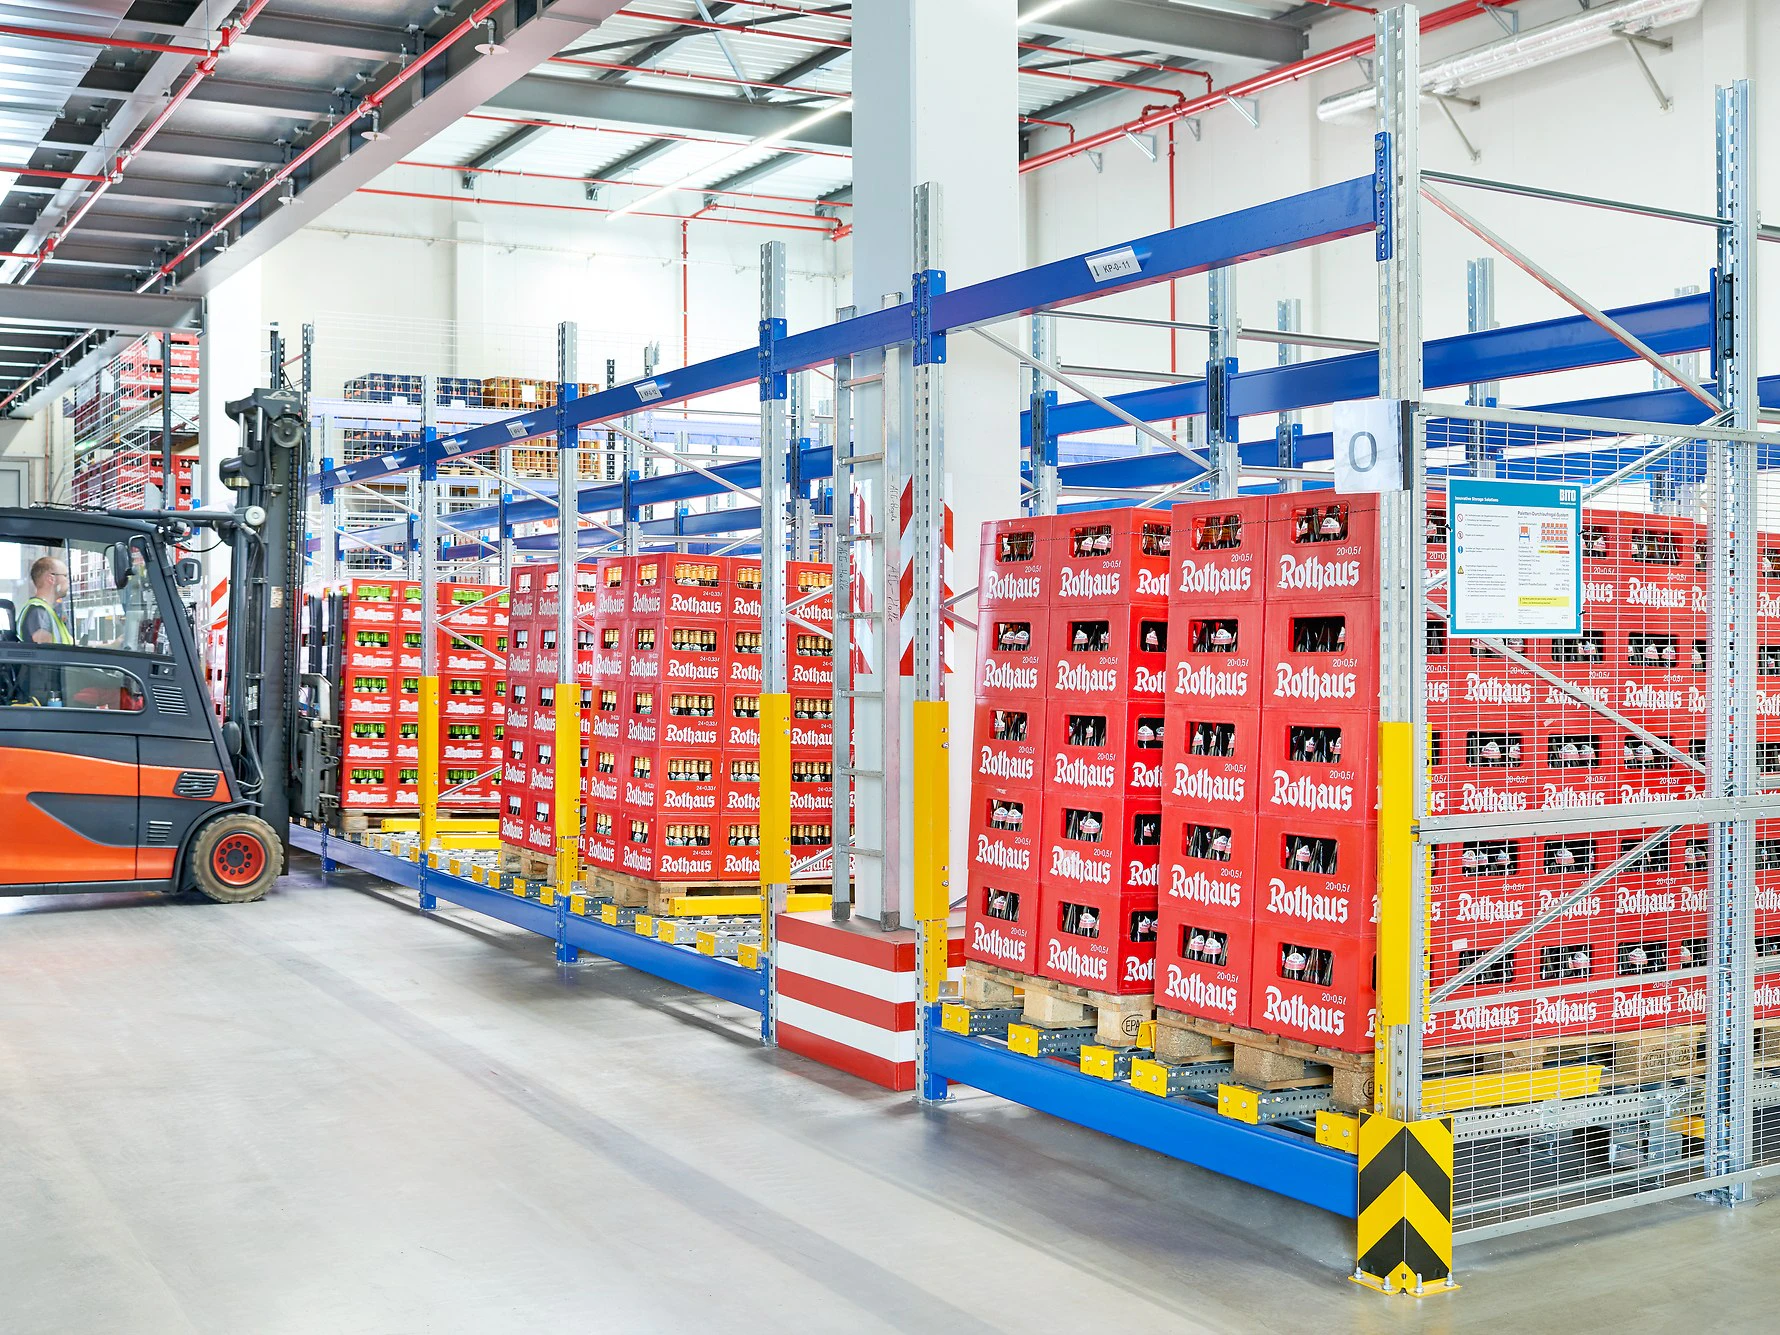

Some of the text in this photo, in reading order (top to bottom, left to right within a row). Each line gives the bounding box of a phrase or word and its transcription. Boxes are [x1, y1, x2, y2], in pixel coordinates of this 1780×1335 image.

[1560, 489, 1576, 501] BITO
[986, 571, 1041, 601] Rothaus
[1059, 567, 1120, 599] Rothaus
[1179, 560, 1252, 595] Rothaus
[1277, 554, 1360, 591] Rothaus
[670, 594, 722, 614] Rothaus
[1626, 577, 1686, 609] Rothaus
[667, 659, 719, 680] Rothaus
[983, 659, 1038, 692] Rothaus
[1055, 660, 1117, 694] Rothaus
[1175, 662, 1248, 699] Rothaus
[1273, 663, 1356, 702] Rothaus
[1464, 673, 1531, 706] Rothaus
[1623, 680, 1682, 712] Rothaus
[665, 724, 717, 745] Rothaus
[979, 745, 1034, 780] Rothaus
[1054, 753, 1115, 789] Rothaus
[1172, 762, 1245, 803] Rothaus
[1270, 770, 1353, 812] Rothaus
[1460, 783, 1527, 813] Rothaus
[664, 789, 715, 810] Rothaus
[660, 855, 712, 875] Rothaus
[976, 834, 1030, 871] Rothaus
[1050, 846, 1111, 884] Rothaus
[1168, 864, 1241, 907] Rothaus
[1266, 878, 1349, 923] Rothaus
[1616, 887, 1675, 916] Rothaus
[1456, 893, 1523, 924] Rothaus
[972, 922, 1026, 962] Rothaus
[1047, 938, 1107, 981] Rothaus
[1165, 964, 1238, 1011] Rothaus
[1263, 986, 1345, 1035] Rothaus
[1534, 998, 1598, 1026] Rothaus
[1612, 991, 1672, 1019] Rothaus
